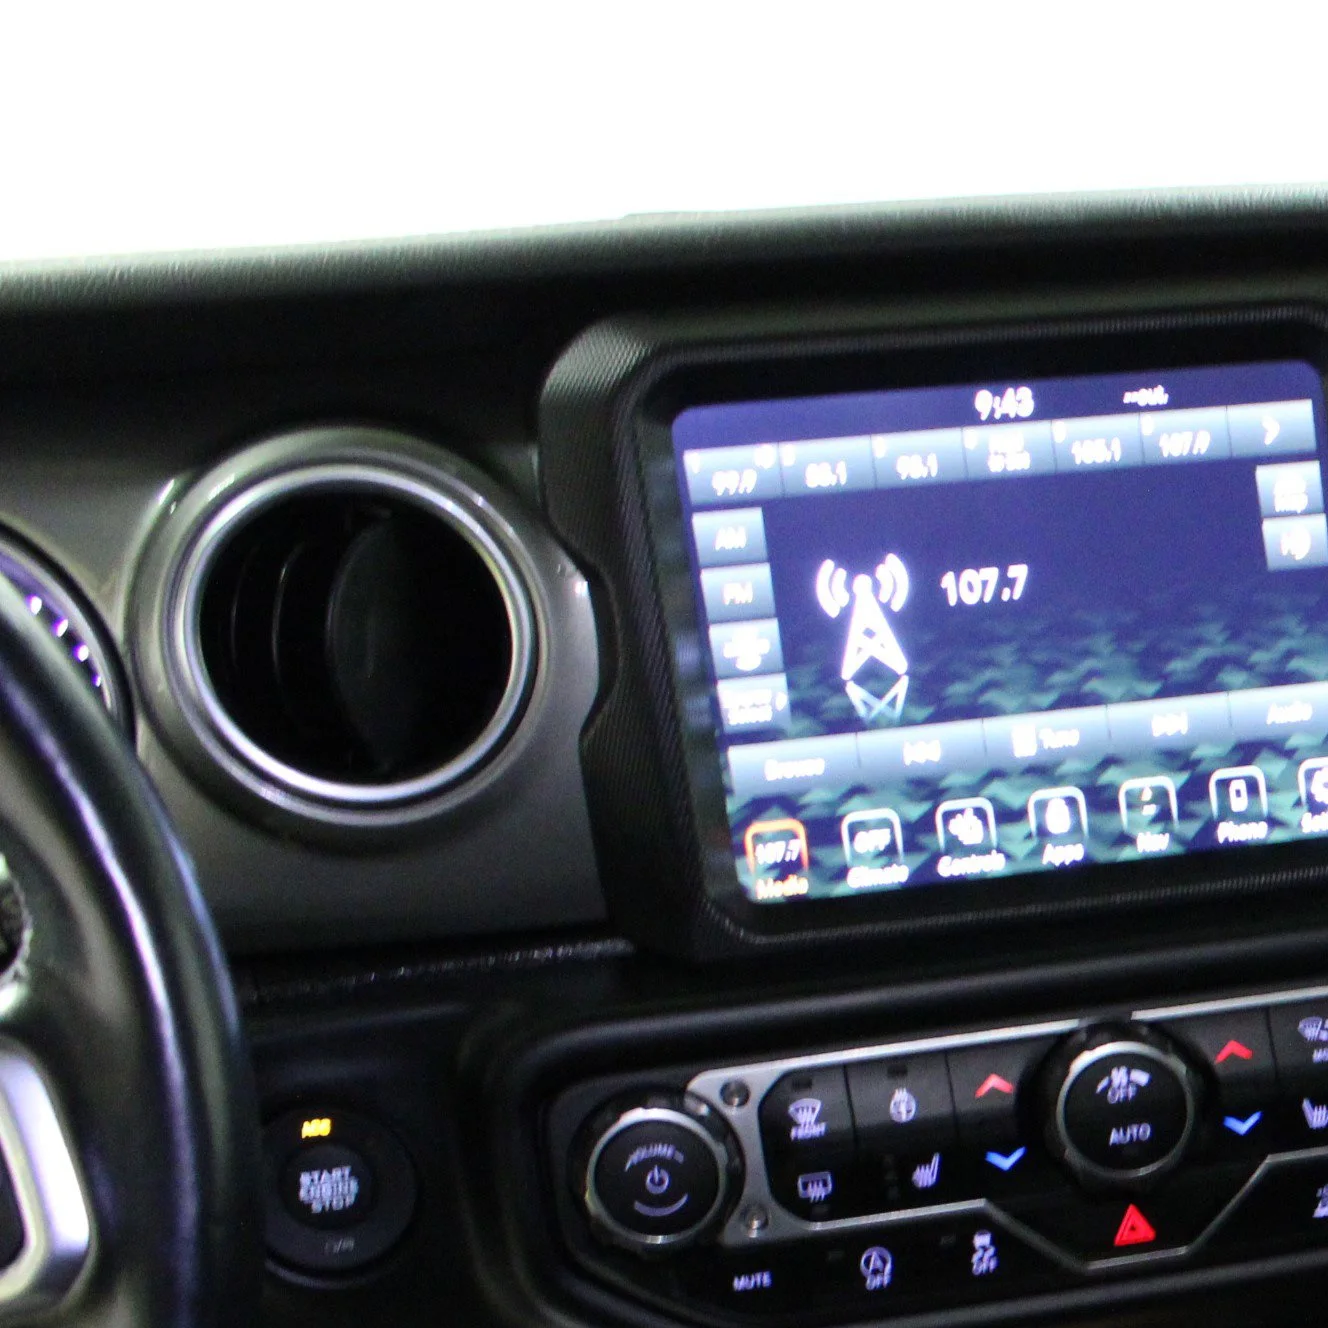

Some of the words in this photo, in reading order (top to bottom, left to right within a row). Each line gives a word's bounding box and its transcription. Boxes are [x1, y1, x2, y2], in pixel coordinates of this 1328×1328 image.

[974, 386, 1034, 420] 9:43
[722, 580, 754, 606] FM
[941, 563, 1029, 607] 107.7
[1267, 700, 1314, 726] Audio
[1136, 830, 1171, 855] Nav
[1218, 818, 1268, 844] Phone
[937, 850, 1006, 878] Controls
[1043, 841, 1085, 867] Apps
[757, 874, 809, 900] Media
[846, 863, 910, 890] Climate
[1107, 1083, 1139, 1104] OFF
[790, 1121, 827, 1141] FRONT
[1108, 1121, 1152, 1147] AUTO
[300, 1165, 353, 1186] START
[311, 1195, 356, 1215] STOP
[972, 1256, 998, 1277] OFF
[733, 1270, 772, 1292] MUTE
[866, 1270, 892, 1292] OFF
